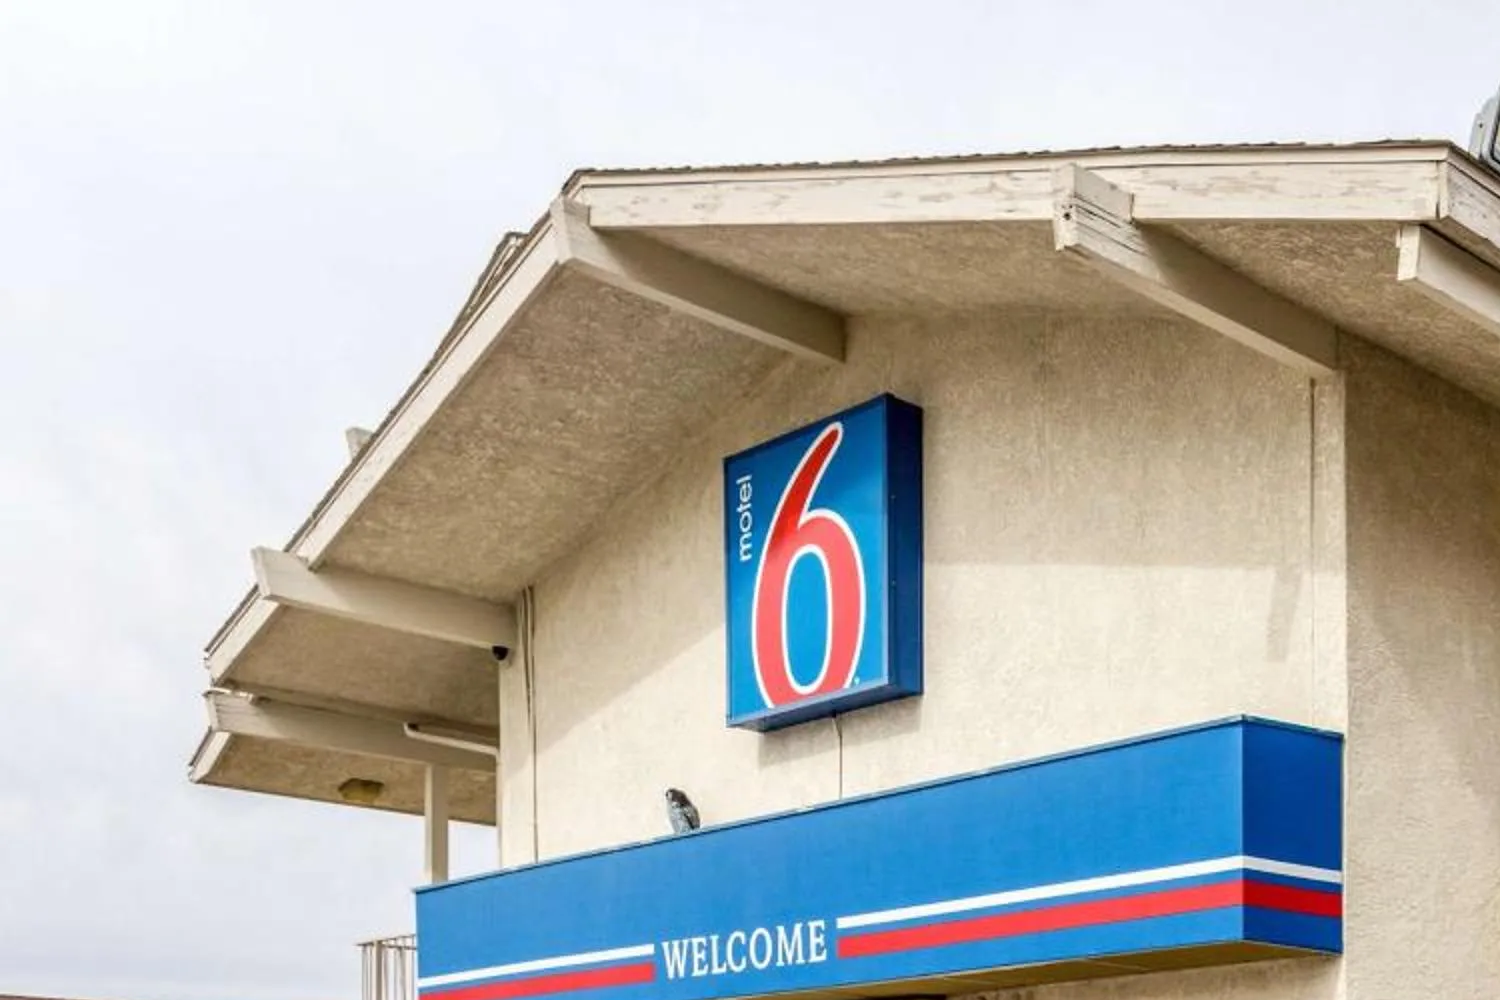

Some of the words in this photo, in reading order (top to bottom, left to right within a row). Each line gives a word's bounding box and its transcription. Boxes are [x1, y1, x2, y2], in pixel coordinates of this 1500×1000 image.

[736, 475, 752, 562] motel
[752, 421, 866, 708] 6
[661, 919, 827, 980] WELCOME
